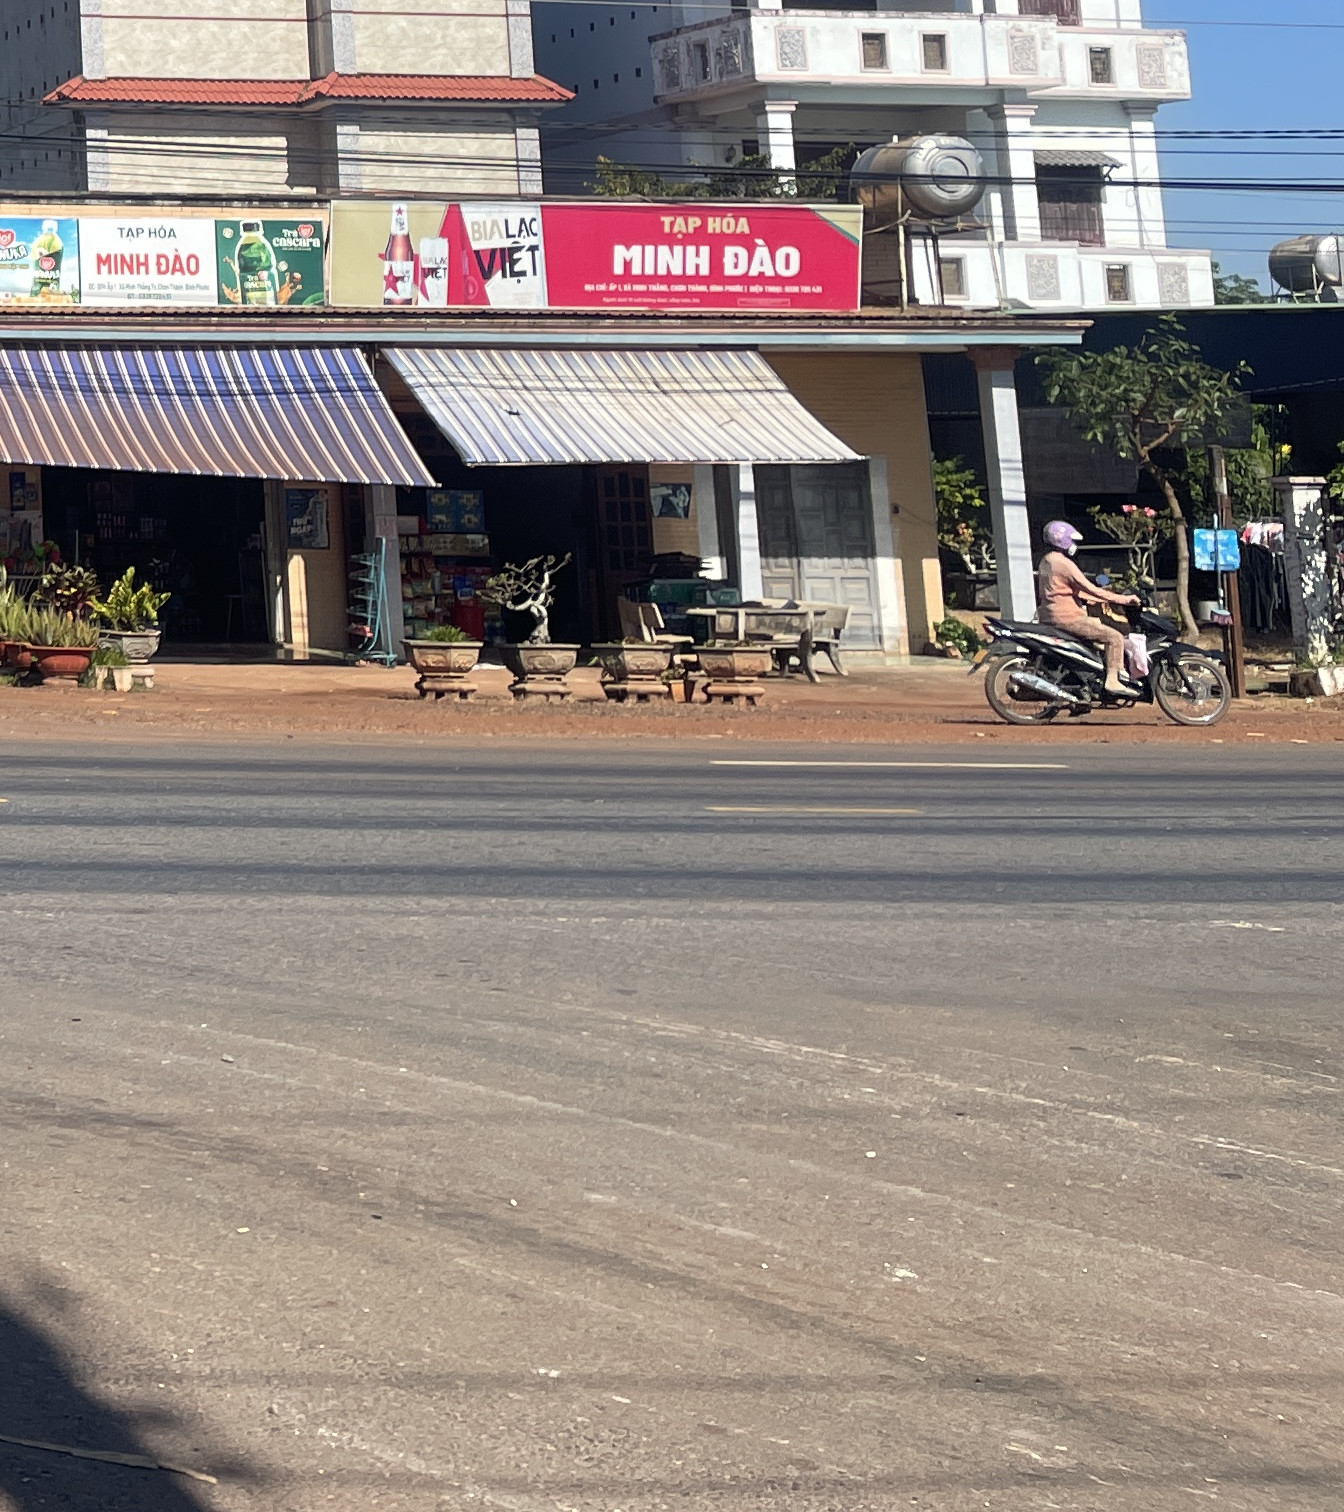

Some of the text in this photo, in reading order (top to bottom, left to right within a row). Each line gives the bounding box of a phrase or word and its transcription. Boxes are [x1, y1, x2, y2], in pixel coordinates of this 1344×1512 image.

[117, 225, 177, 242] TẠP HÓA
[470, 217, 538, 242] BIA LẠC
[660, 213, 751, 239] TẠP HÓA
[272, 237, 321, 248] cascara
[96, 248, 200, 276] MINH ĐÀO
[473, 241, 540, 284] VIỆT
[613, 239, 801, 277] MINH ĐÀO
